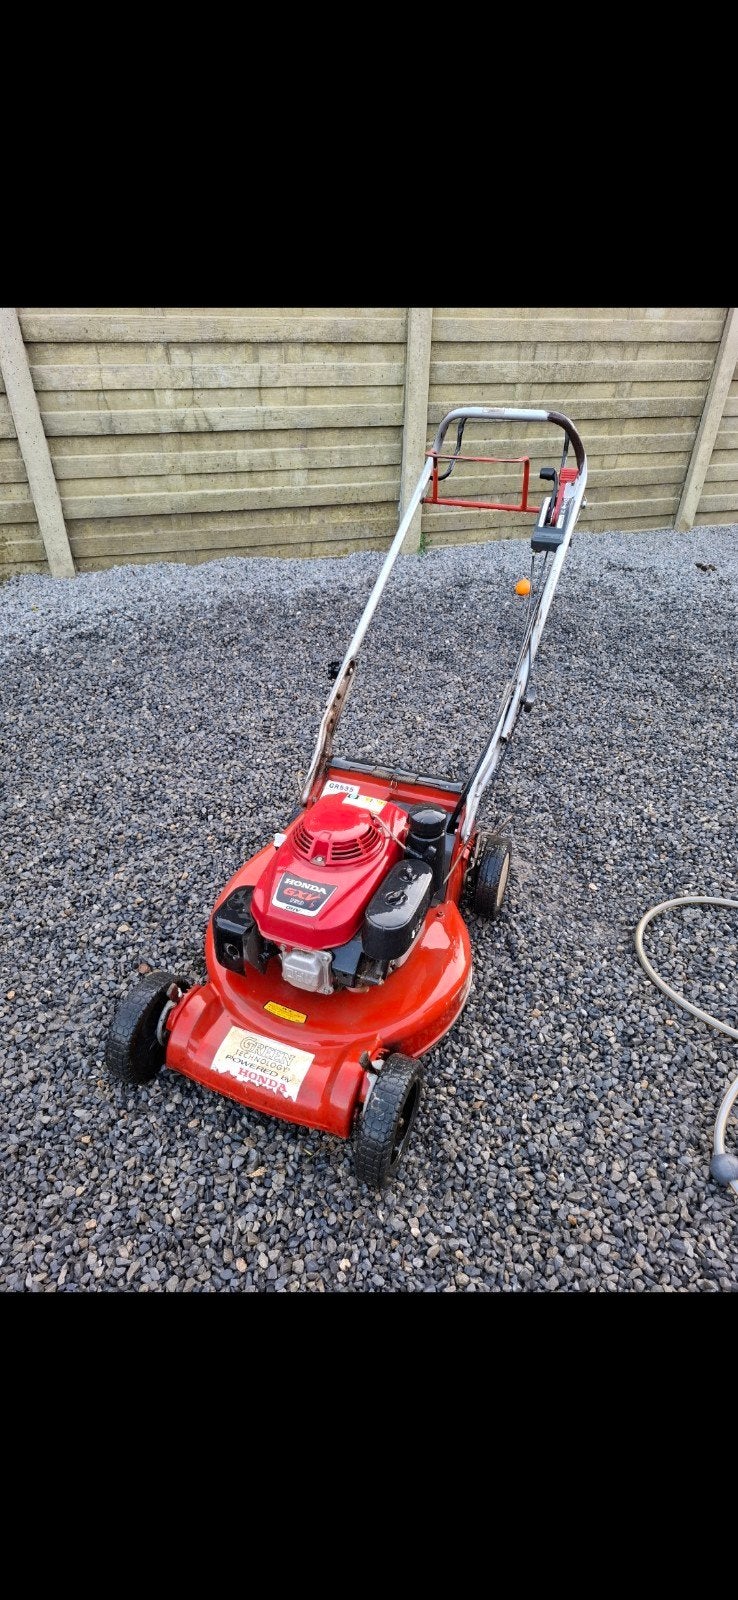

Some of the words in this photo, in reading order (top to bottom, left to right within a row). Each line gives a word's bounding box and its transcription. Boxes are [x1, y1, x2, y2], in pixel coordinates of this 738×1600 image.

[329, 782, 354, 793] GR535
[283, 887, 321, 901] GXV
[284, 878, 327, 895] HONDA
[236, 1049, 289, 1073] TECHNOLOGY
[240, 1036, 296, 1067] GREEN
[225, 1054, 279, 1078] POWERED
[238, 1067, 288, 1093] HONDA
